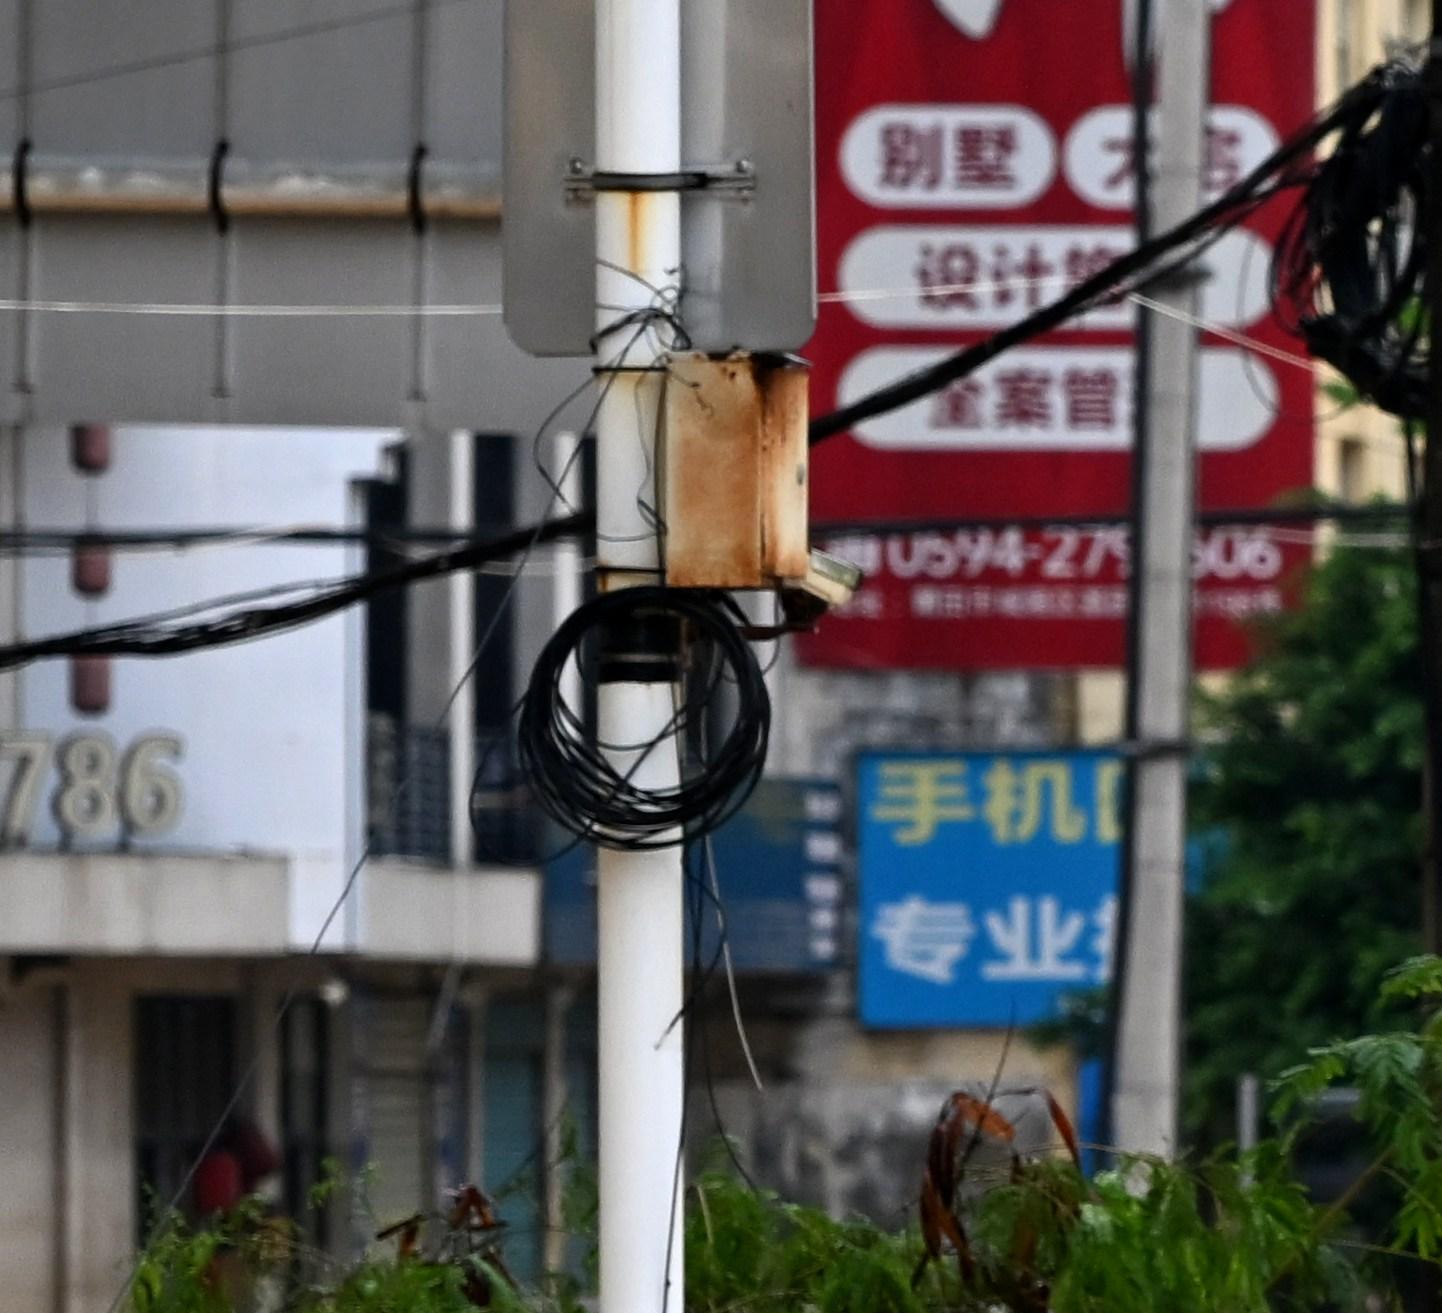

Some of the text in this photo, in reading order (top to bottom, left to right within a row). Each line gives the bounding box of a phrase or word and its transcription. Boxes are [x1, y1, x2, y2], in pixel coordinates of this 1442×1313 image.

[879, 121, 1018, 190] 别墅
[868, 759, 1122, 842] 手机
[870, 895, 1118, 979] 专业
